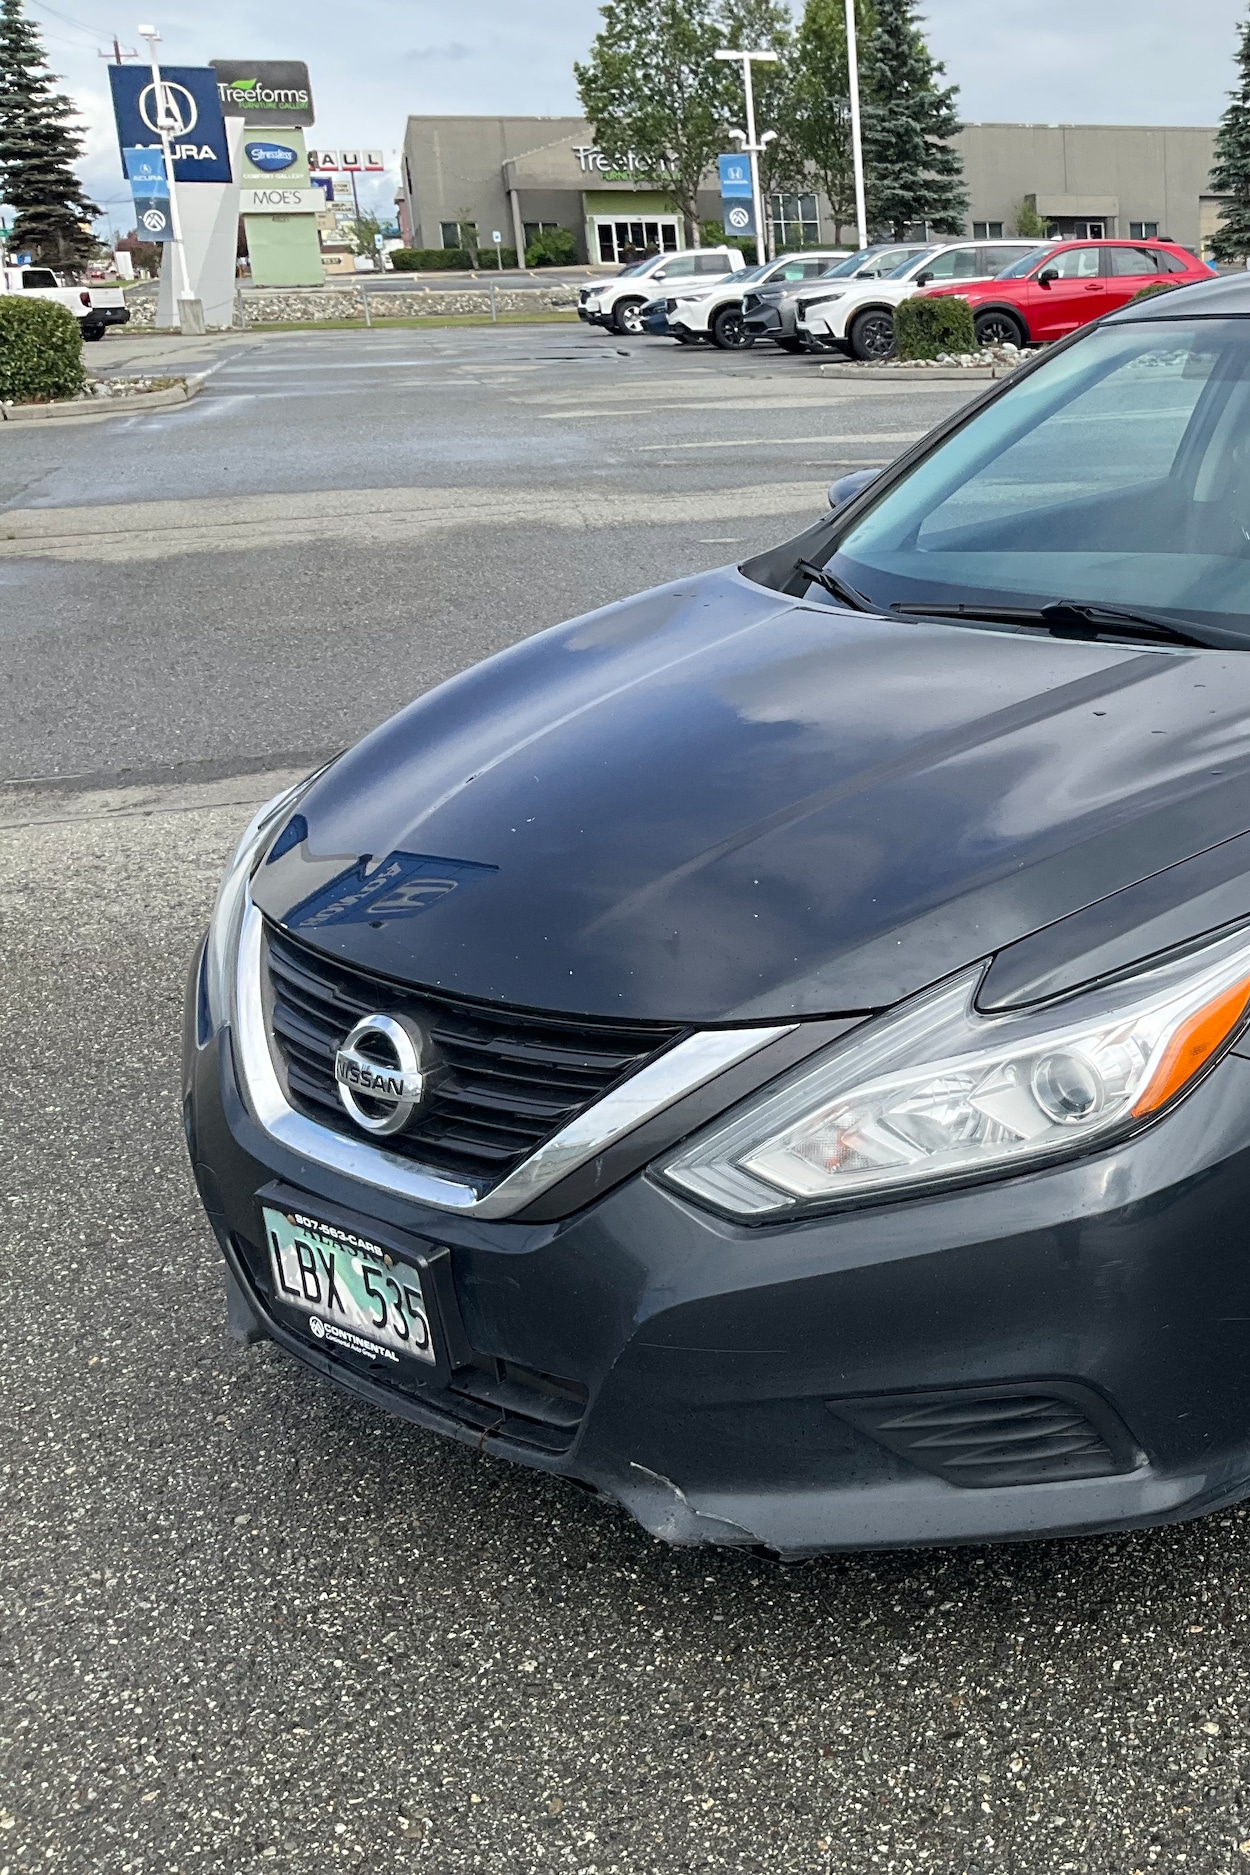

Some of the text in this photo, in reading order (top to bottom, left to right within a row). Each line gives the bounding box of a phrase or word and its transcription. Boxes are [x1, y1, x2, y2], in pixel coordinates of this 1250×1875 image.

[217, 82, 308, 102] Treeforms
[239, 101, 277, 109] FURNITURE
[135, 144, 217, 160] URA
[251, 148, 293, 161] Stressless
[254, 190, 302, 204] MOE'S
[338, 1061, 404, 1096] NISSAN
[294, 1213, 384, 1257] 907-563-CARS
[271, 1230, 430, 1350] LBX 535
[323, 1322, 400, 1363] CONTINENTAL
